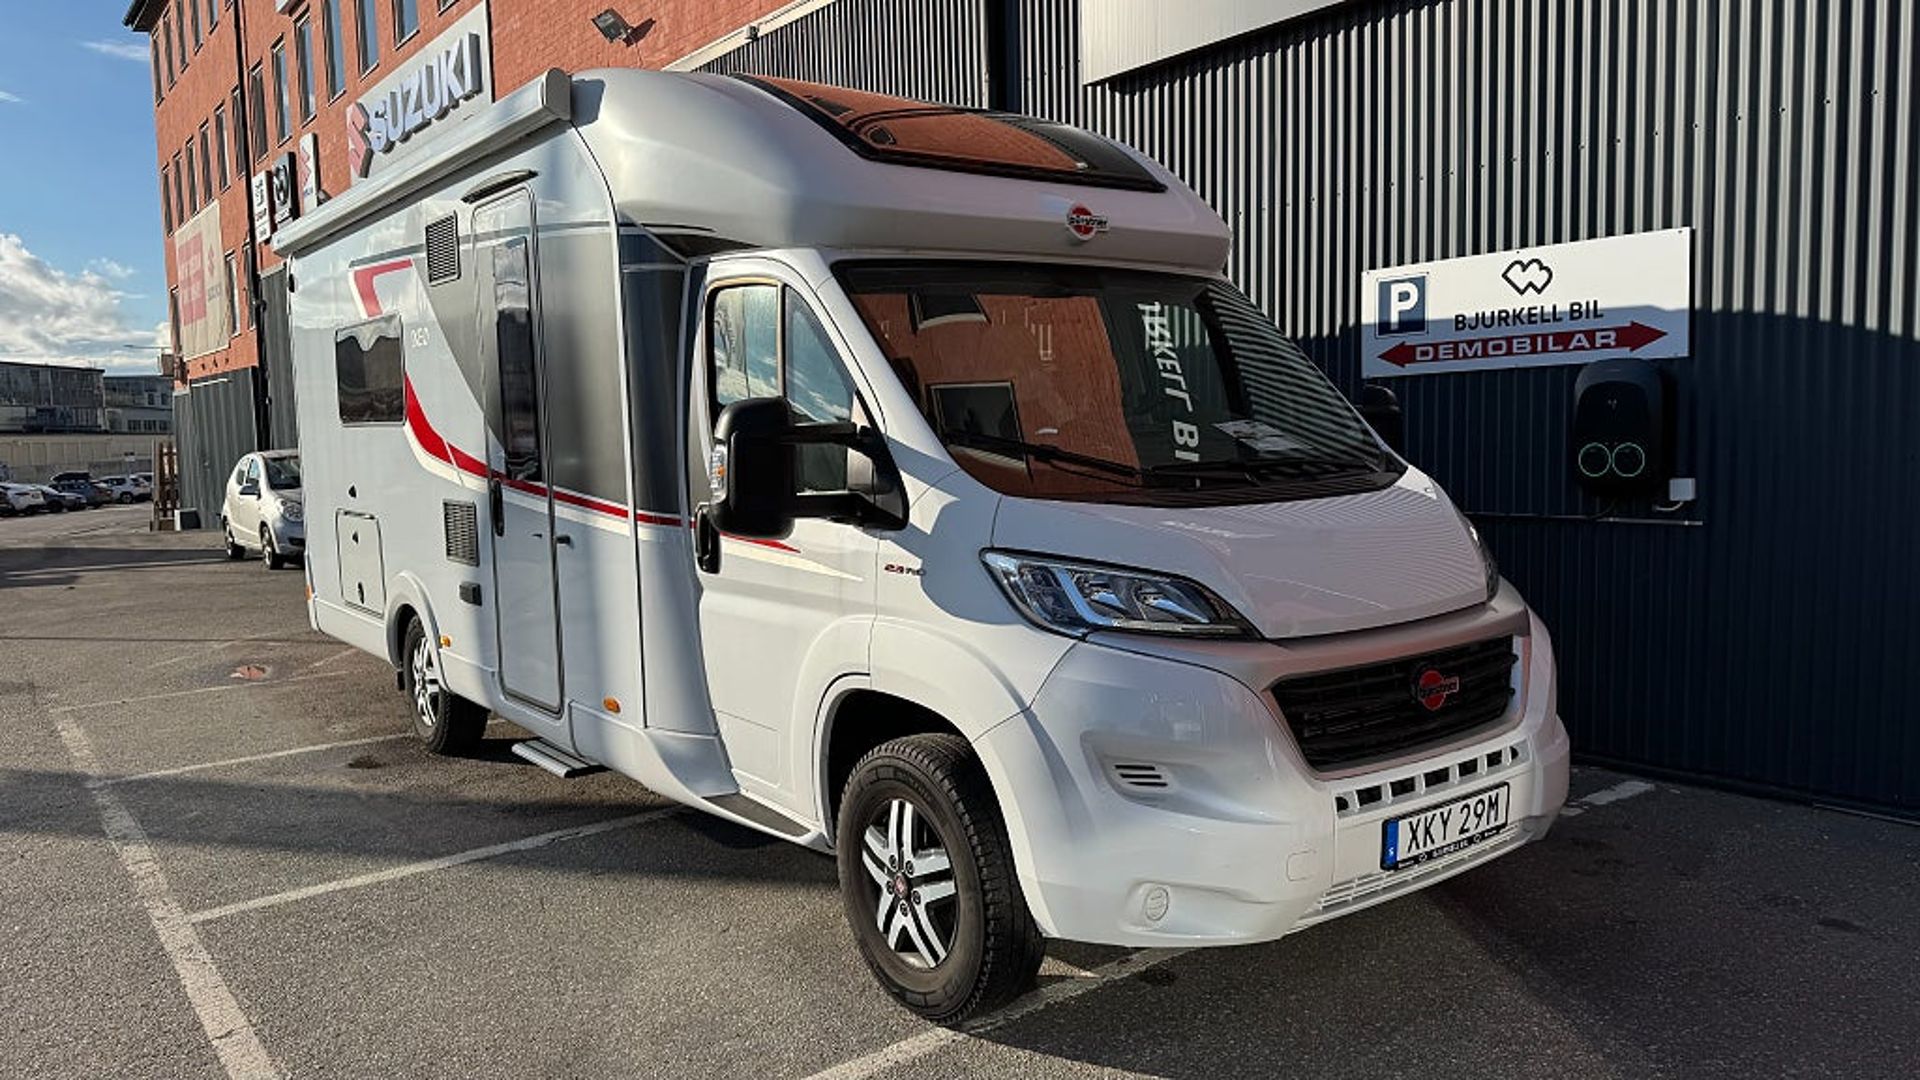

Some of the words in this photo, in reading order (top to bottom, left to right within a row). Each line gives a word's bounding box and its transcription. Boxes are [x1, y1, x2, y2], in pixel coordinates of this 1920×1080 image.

[368, 32, 482, 153] SUZUKI
[1390, 282, 1419, 331] P
[1454, 304, 1563, 332] BJURKELL
[1569, 299, 1604, 321] BIL
[1415, 330, 1617, 362] DEMOBILAR
[1407, 807, 1452, 853] XKY
[1458, 792, 1500, 835] 29M
